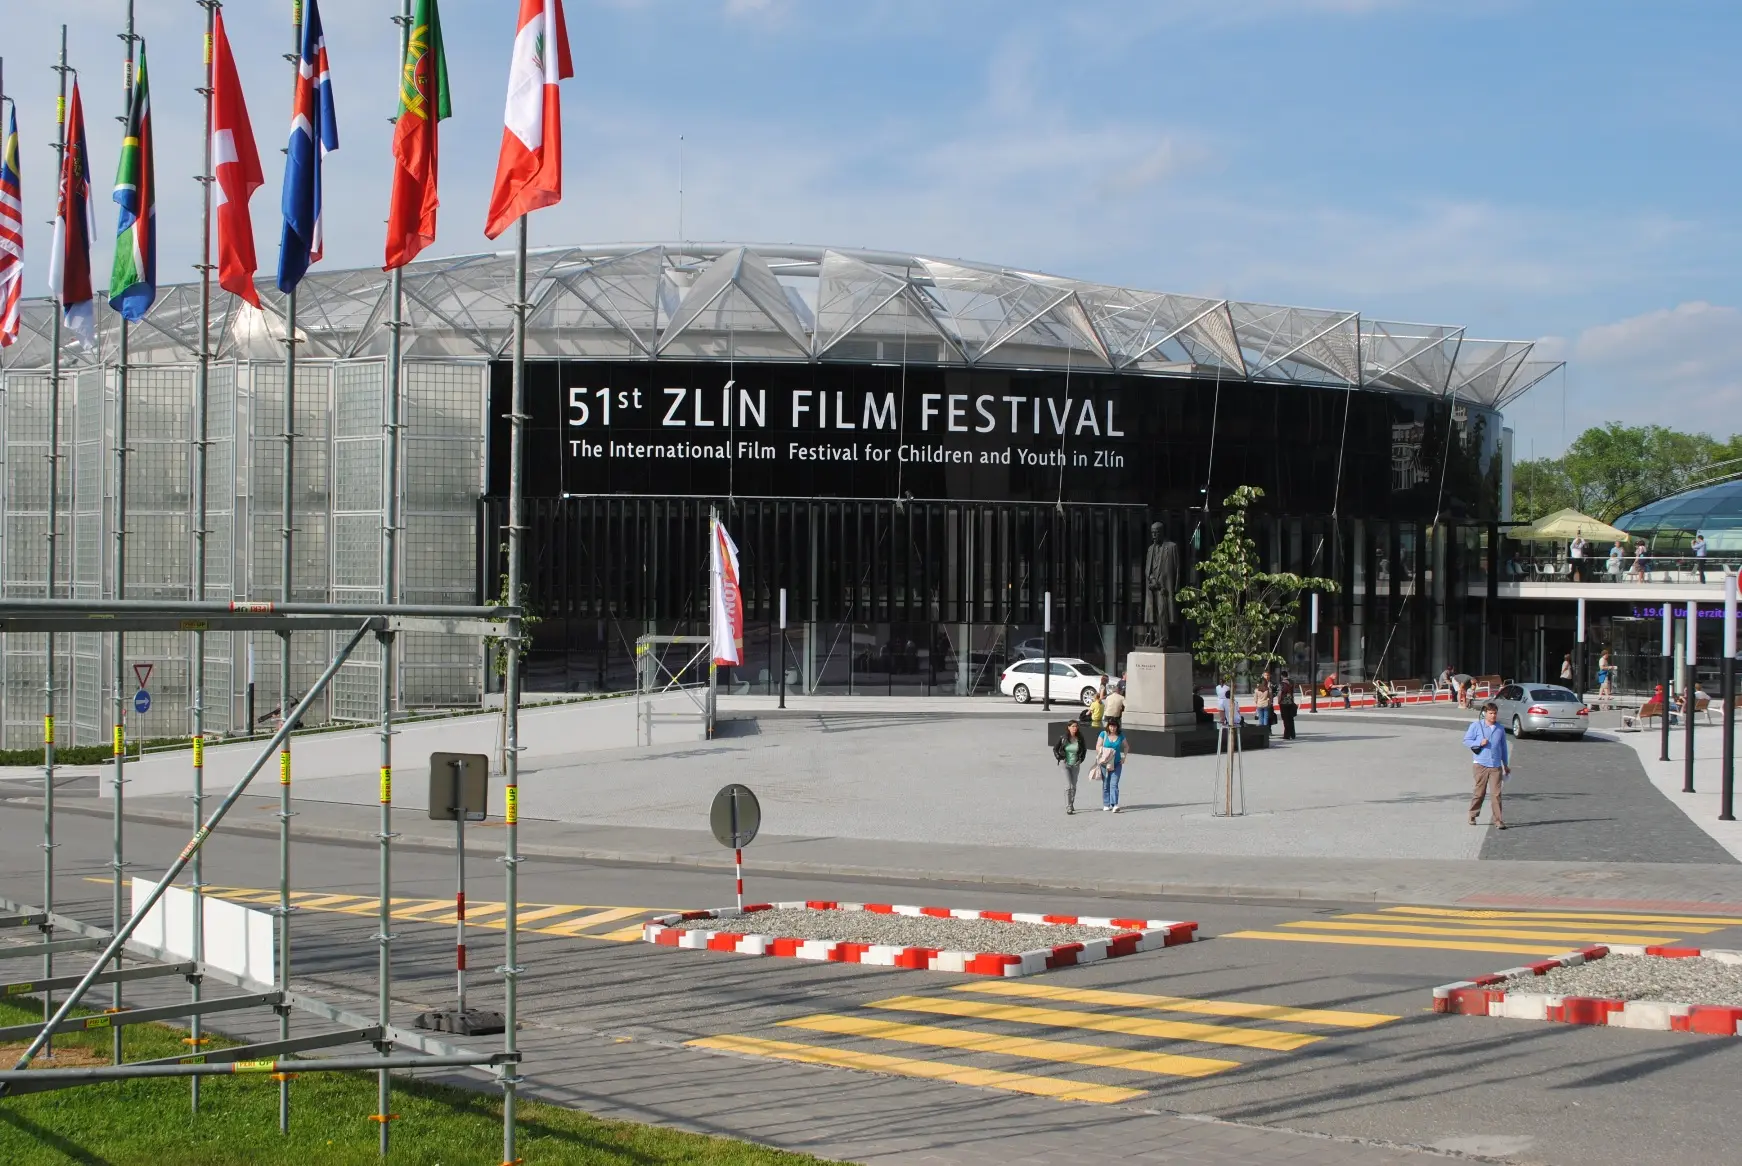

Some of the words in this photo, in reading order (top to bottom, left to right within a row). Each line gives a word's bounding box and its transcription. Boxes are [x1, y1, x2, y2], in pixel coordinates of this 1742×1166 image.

[568, 387, 643, 426] 51st
[662, 380, 766, 427] ZLÍN
[792, 390, 897, 430] FILM
[921, 393, 1125, 437] FESTIVAL
[569, 440, 604, 458] The
[610, 440, 732, 460] International
[738, 441, 776, 460] Film
[789, 442, 858, 462] Festival
[864, 443, 891, 462] for
[898, 445, 974, 466] Children
[979, 447, 1011, 466] and
[1018, 448, 1066, 467] Youth
[1073, 450, 1088, 467] in
[1093, 450, 1124, 469] Zlín
[195, 738, 201, 749] UP
[385, 769, 391, 782] UP
[508, 788, 516, 801] UP
[508, 803, 516, 819] PERI
